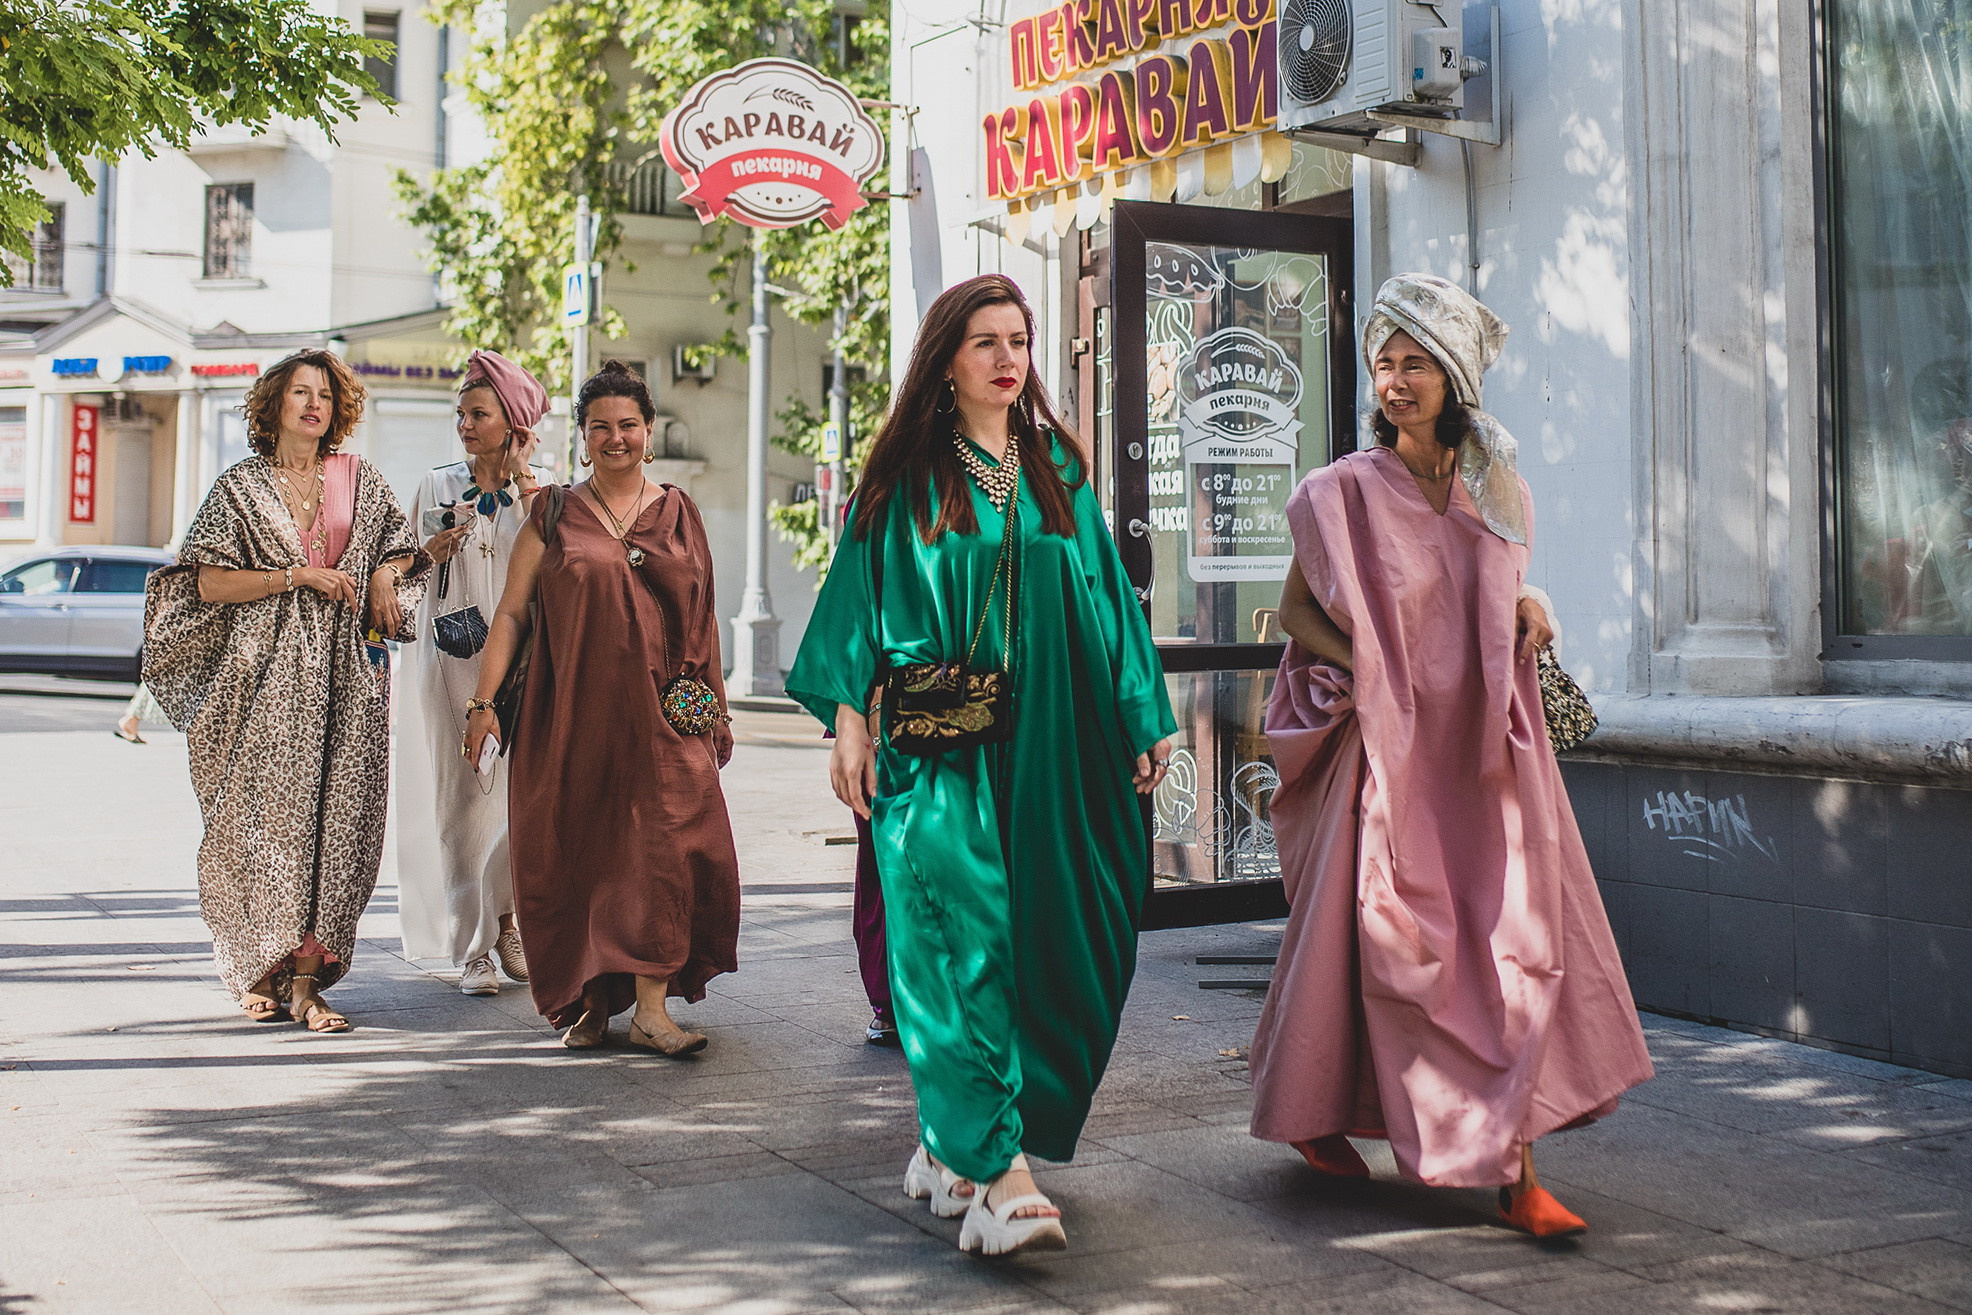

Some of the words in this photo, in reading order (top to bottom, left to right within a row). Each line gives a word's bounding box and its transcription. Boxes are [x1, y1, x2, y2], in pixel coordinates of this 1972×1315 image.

[983, 0, 1277, 200] КАРАВАЙ
[696, 112, 855, 157] КАРАВАЙ
[731, 157, 822, 181] пекарня
[1194, 362, 1283, 394] КАРАВАЙ
[1209, 394, 1271, 411] пекарня
[1208, 447, 1238, 458] РЕЖИМ
[1239, 448, 1274, 458] РАБОТЫ
[74, 408, 93, 519] ЗАЙМЫ
[1231, 477, 1254, 494] до
[1215, 494, 1249, 506] будние
[1250, 496, 1268, 505] дни
[1232, 518, 1254, 535] до
[1200, 534, 1230, 545] суббота
[1231, 536, 1237, 544] и
[1238, 536, 1285, 545] воскресенье
